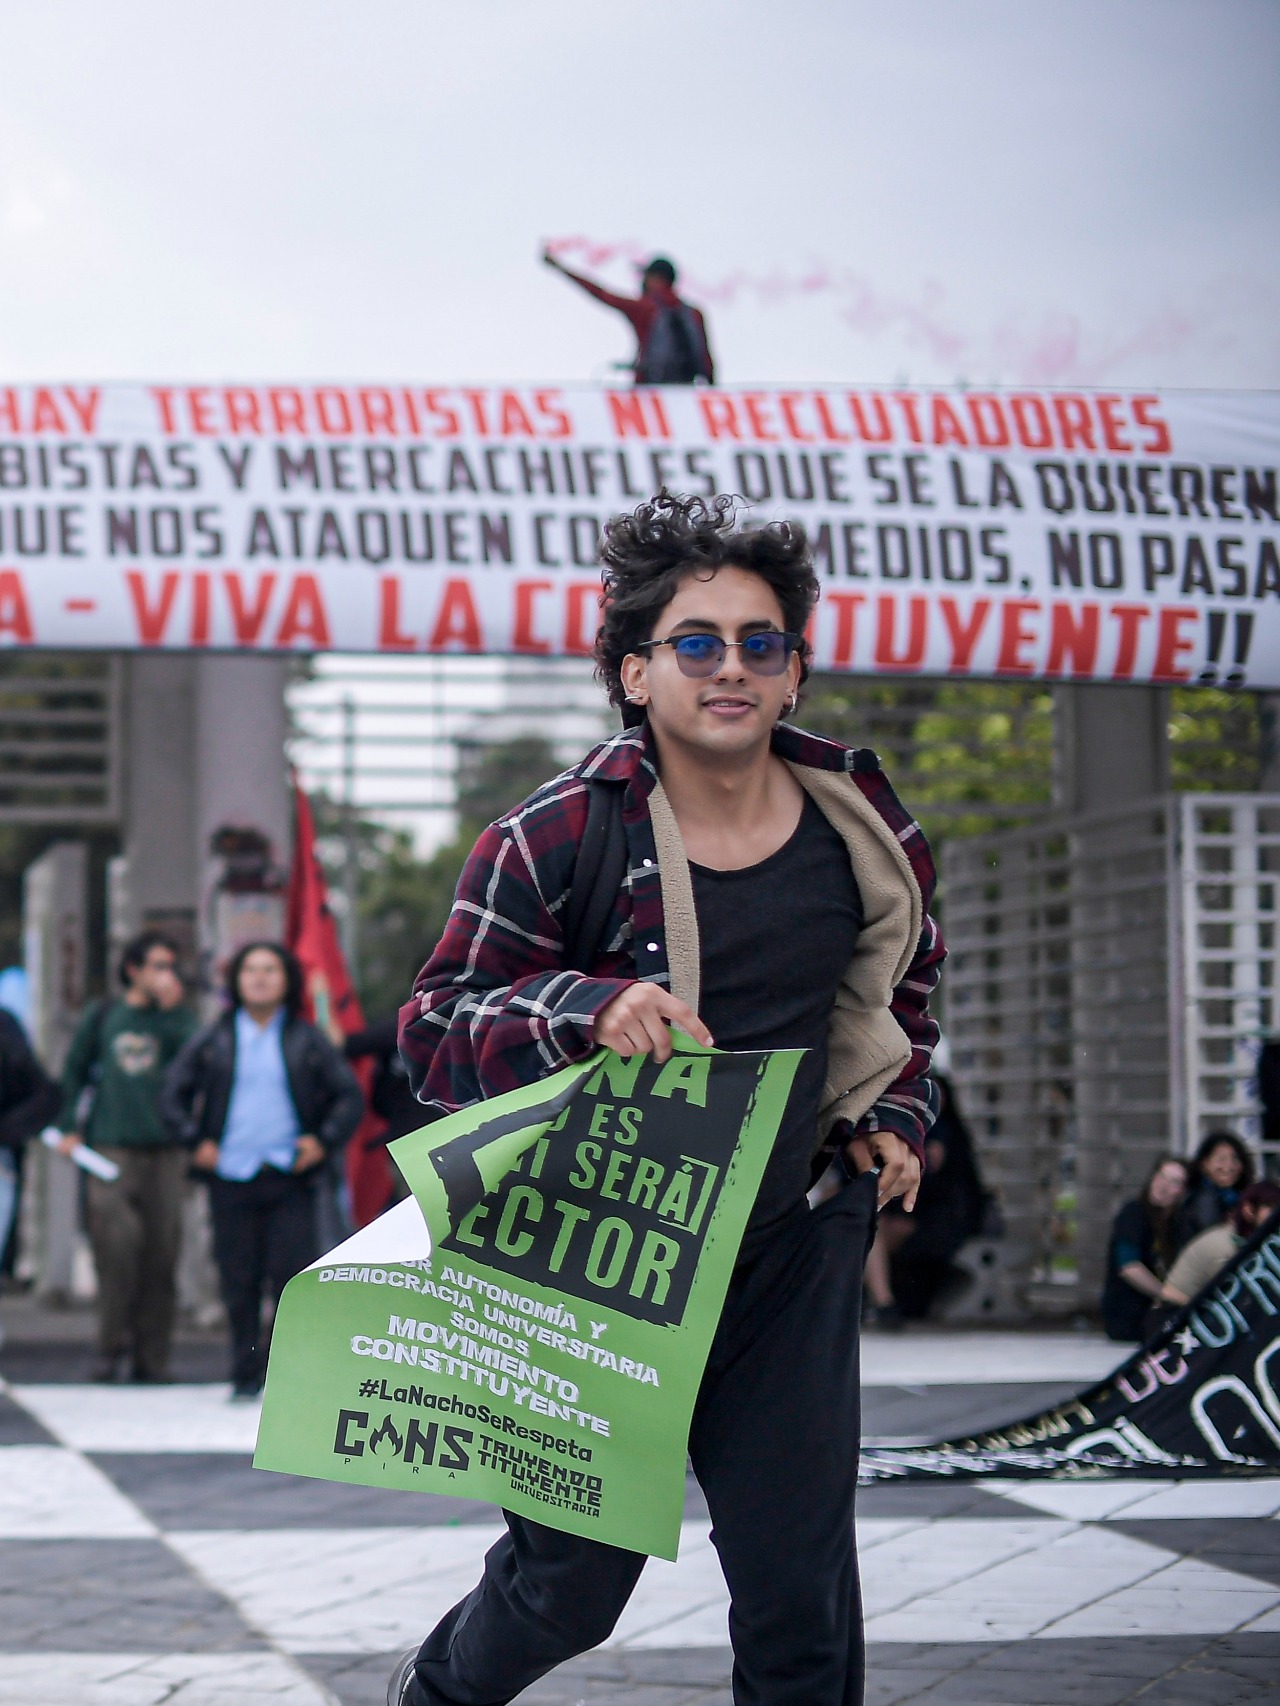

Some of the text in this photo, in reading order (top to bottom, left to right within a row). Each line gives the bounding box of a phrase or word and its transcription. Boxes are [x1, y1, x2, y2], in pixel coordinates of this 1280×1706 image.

[150, 386, 574, 439] TERRORISTAS
[605, 389, 674, 442] NI
[697, 391, 1174, 456] RECLUTADORES
[219, 445, 252, 491] Y
[274, 446, 717, 500] MERCACHIFLES
[732, 452, 852, 506] QUE
[865, 453, 940, 509] SE
[950, 457, 1022, 512] LA
[1032, 459, 1280, 525] QUIEREN
[106, 506, 224, 560] NOS
[246, 508, 514, 567] ATAQUEN
[533, 513, 603, 568] CO
[1046, 528, 1126, 594] NO
[124, 568, 333, 650] VIVA
[375, 574, 487, 653] LA
[587, 1103, 643, 1146] ES
[455, 1184, 681, 1307] ECTOR
[317, 1266, 661, 1388] DEMOCRACIA UNIVERSITARIA
[440, 1264, 578, 1333] AUTONOMÍA
[587, 1319, 609, 1341] Y
[449, 1310, 531, 1359] SOMOS
[350, 1334, 612, 1439] CONSTITUYENTE
[386, 1314, 581, 1404] MOVIMIENTO
[358, 1378, 594, 1464] #LaNachoSeRespeta
[477, 1448, 603, 1508] TITUYENTE
[478, 1432, 603, 1493] TRUYENDO
[509, 1479, 601, 1519] UNIVERSITARIA
